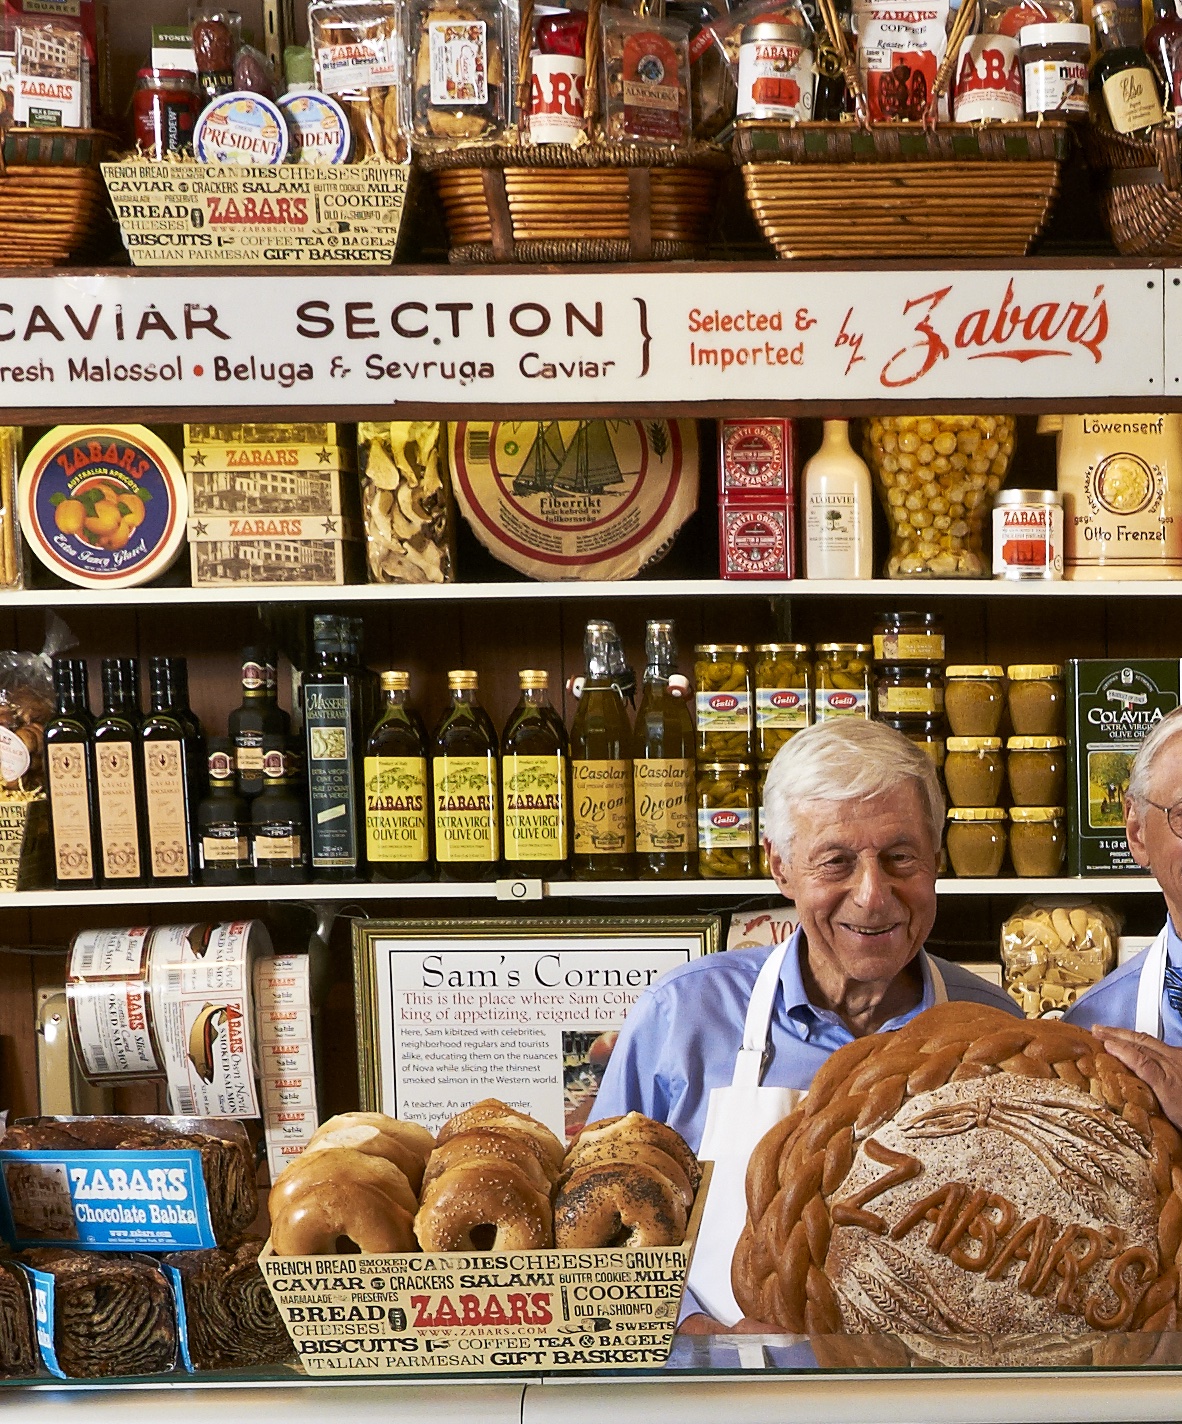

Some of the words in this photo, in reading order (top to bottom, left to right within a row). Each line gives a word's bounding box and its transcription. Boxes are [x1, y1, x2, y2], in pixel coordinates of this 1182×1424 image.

[203, 128, 279, 158] PRÉSIDENT
[297, 301, 604, 341] SECTION
[690, 308, 782, 342] Selected
[835, 306, 867, 376] by
[690, 343, 804, 378] Imported
[0, 355, 54, 383] resh
[68, 356, 183, 383] Malossol
[214, 355, 314, 388] Beluga
[366, 353, 495, 386] Sevruga
[520, 352, 615, 379] Caviar
[1083, 418, 1164, 436] Löwensenf
[540, 496, 602, 511] Fiberrikt
[1084, 525, 1107, 542] Otto
[1116, 525, 1167, 542] Frenzel
[1087, 706, 1166, 725] COLAVITA
[1100, 722, 1125, 732] EXTRA
[1109, 730, 1131, 739] OLIVE
[367, 817, 392, 829] EXTRA
[392, 816, 426, 828] VIRGIN
[373, 828, 397, 842] OLIVE
[398, 829, 418, 842] OIL
[422, 955, 520, 989] Sam's
[534, 954, 658, 988] Corner
[403, 991, 433, 1006] This
[438, 991, 449, 1006] is
[453, 991, 473, 1006] the
[479, 991, 515, 1008] place
[521, 991, 564, 1006] where
[570, 991, 597, 1006] Sam
[401, 1007, 431, 1024] king
[436, 1007, 451, 1022] of
[453, 1007, 532, 1024] appetizing,
[536, 1007, 591, 1024] reigned
[595, 1007, 617, 1022] for
[425, 1028, 442, 1037] Sam
[481, 1028, 499, 1037] with
[75, 1203, 146, 1224] Chocolate
[149, 1204, 198, 1225] Babka
[265, 1261, 313, 1277] FRENCH
[315, 1259, 356, 1275] BREAD
[408, 1256, 508, 1272] CANDIES
[509, 1254, 625, 1271] CHEESES
[272, 1277, 366, 1292] CAVIAR
[390, 1276, 455, 1290] CRACKERS
[459, 1273, 555, 1288] SALAMI
[633, 1270, 686, 1282] MILK
[573, 1284, 683, 1302] COOKIES
[287, 1305, 382, 1323] BREAD
[418, 1326, 548, 1337] WWW.ZABARS.COM
[615, 1320, 676, 1332] SWEETS
[299, 1337, 418, 1355] BISCUITS
[458, 1337, 531, 1351] COFFEE
[533, 1336, 575, 1349] TEA
[598, 1333, 671, 1348] BAGELS
[308, 1355, 380, 1371] ITALIAN
[386, 1353, 485, 1369] PARMESAN
[490, 1352, 546, 1367] GIFT
[553, 1349, 668, 1366] BASKETS
